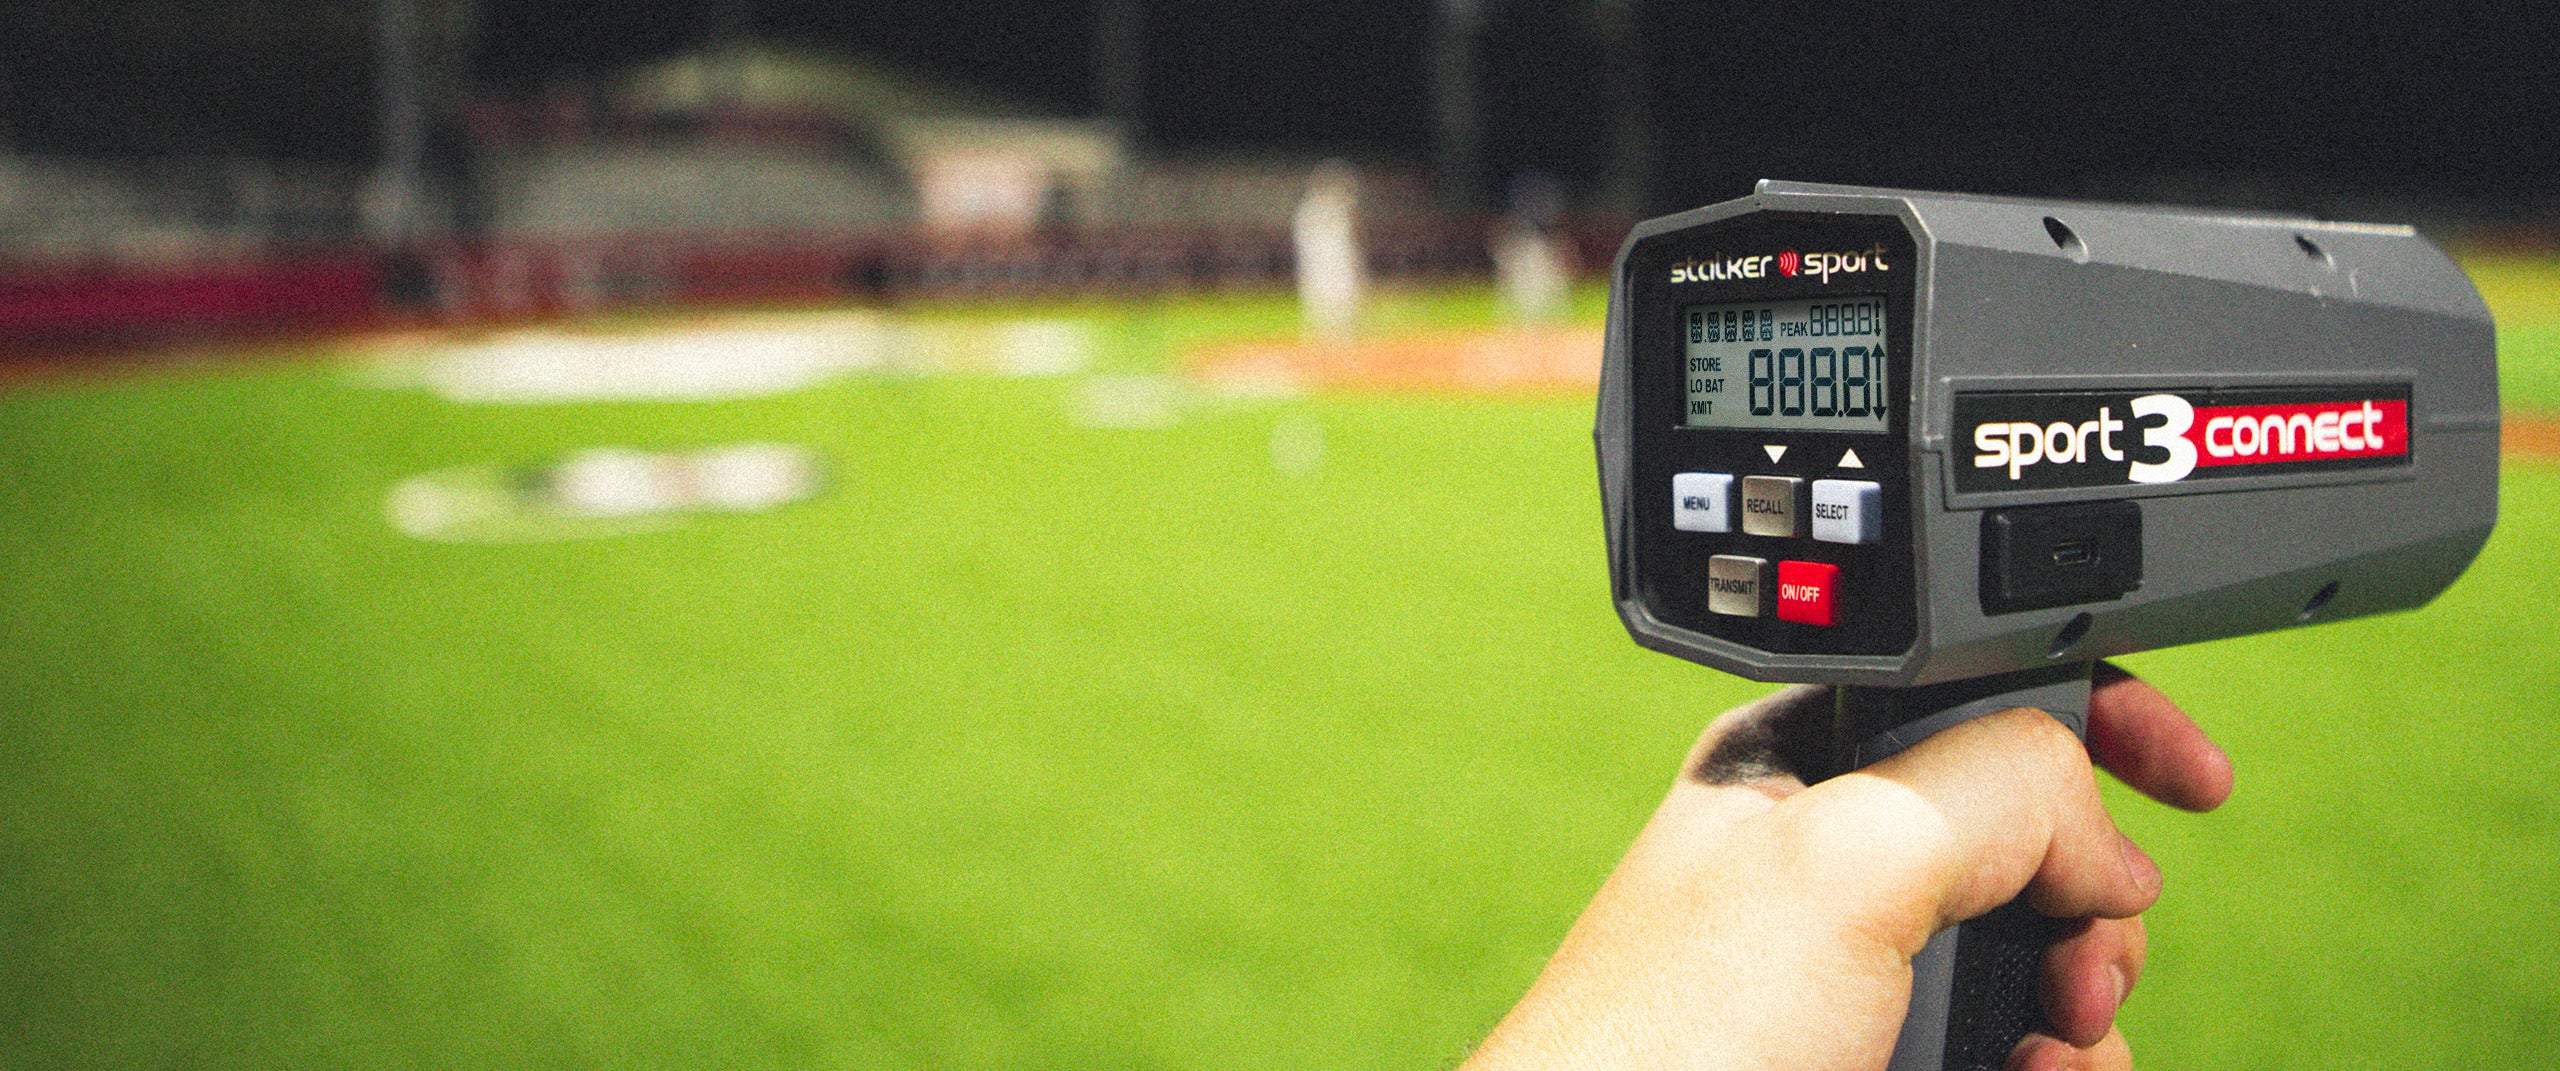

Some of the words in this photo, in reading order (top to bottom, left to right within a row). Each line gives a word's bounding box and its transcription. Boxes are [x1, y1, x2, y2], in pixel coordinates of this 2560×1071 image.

[1804, 243, 1889, 284] sport
[1780, 322, 1808, 336] PEAK
[1810, 303, 1872, 336] 888.8
[1690, 357, 1722, 372] STORE
[1690, 379, 1702, 393] LO
[1706, 379, 1724, 393] BAT
[1749, 346, 1870, 418] 888.8
[1691, 400, 1713, 415] XMIT
[1974, 407, 2124, 480] sport
[2128, 394, 2198, 483] 3
[2205, 400, 2383, 458] connect
[1683, 497, 1710, 511] MENU
[1746, 498, 1784, 515] RECALL
[1815, 503, 1848, 520] SELECT
[1710, 577, 1753, 595] TRANSMIT
[1781, 584, 1820, 602] ON/OFF
